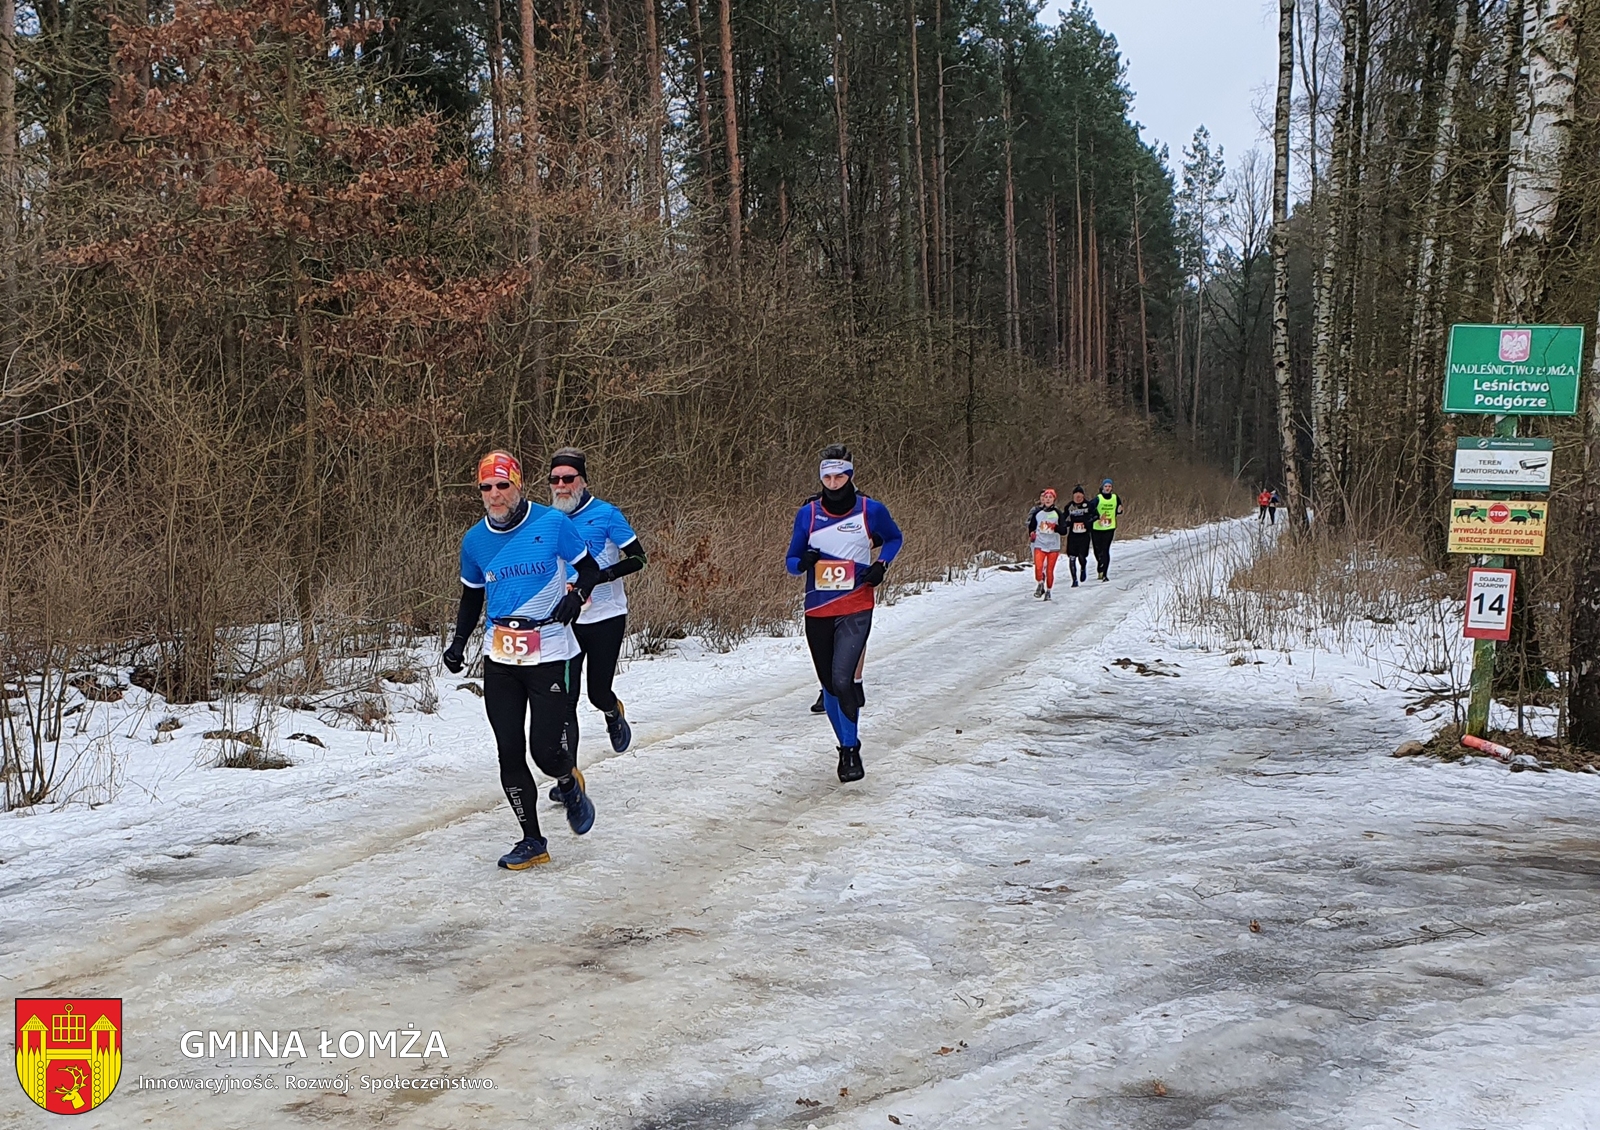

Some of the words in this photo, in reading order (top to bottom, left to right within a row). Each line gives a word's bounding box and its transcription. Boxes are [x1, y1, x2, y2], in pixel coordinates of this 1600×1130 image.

[1451, 362, 1534, 375] NADLEŚNICTWO
[1473, 379, 1550, 392] Leśnictwo
[1474, 394, 1547, 410] Podgórze
[1453, 527, 1487, 535] WYWOŻĄC
[1489, 526, 1511, 535] ŚMIECI
[1497, 537, 1534, 545] PRZYRODĘ
[500, 561, 546, 579] STARGLASS
[821, 566, 846, 583] 49
[1473, 592, 1505, 616] 14
[502, 635, 528, 656] 85
